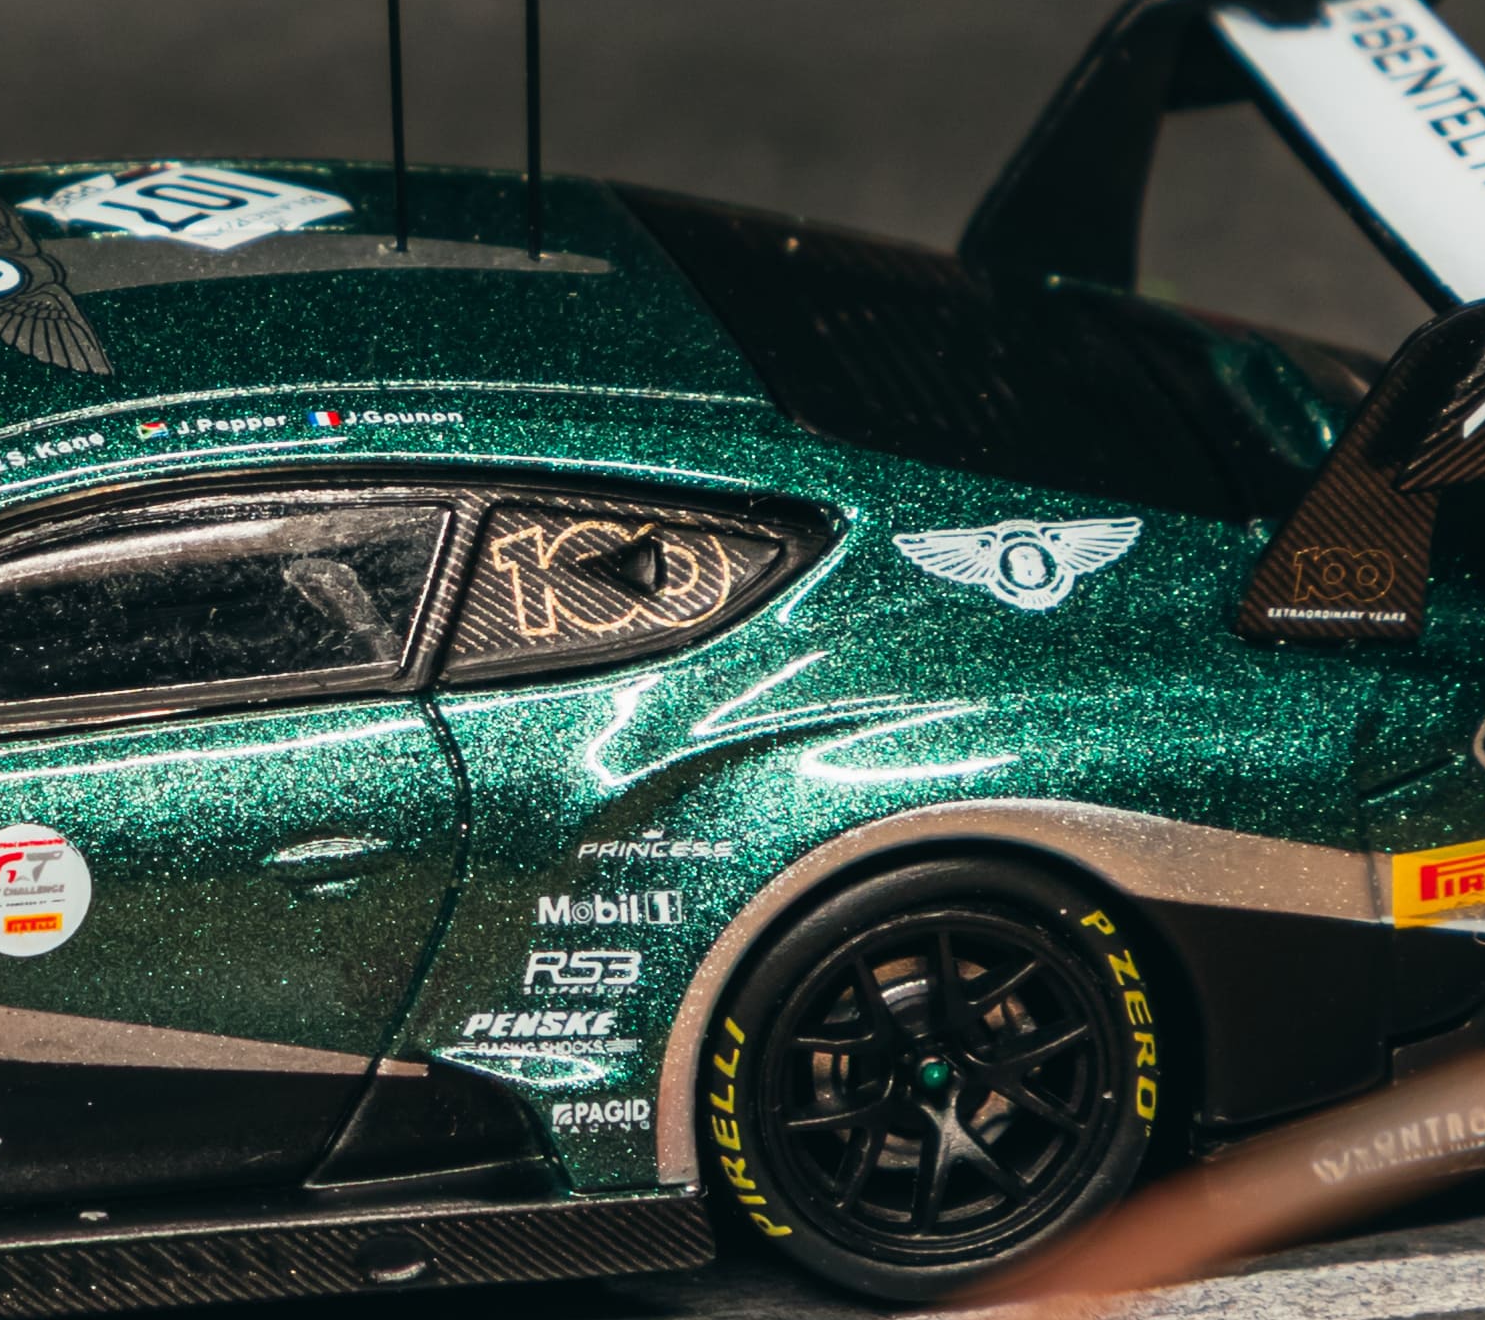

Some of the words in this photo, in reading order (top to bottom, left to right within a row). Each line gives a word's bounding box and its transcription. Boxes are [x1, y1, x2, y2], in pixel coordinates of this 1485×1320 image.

[1293, 546, 1396, 603] 100
[1267, 607, 1365, 620] EXTRAORDINARY
[1367, 611, 1407, 623] YEARS
[577, 841, 733, 859] PRINCESS
[538, 894, 639, 924] Mobil
[462, 1011, 617, 1037] PENSKE
[1080, 910, 1116, 935] P
[1108, 949, 1157, 1121] ZERO
[539, 1039, 605, 1055] SHOCKS
[574, 1099, 651, 1124] PAGID
[710, 1016, 793, 1237] PIRELLI
